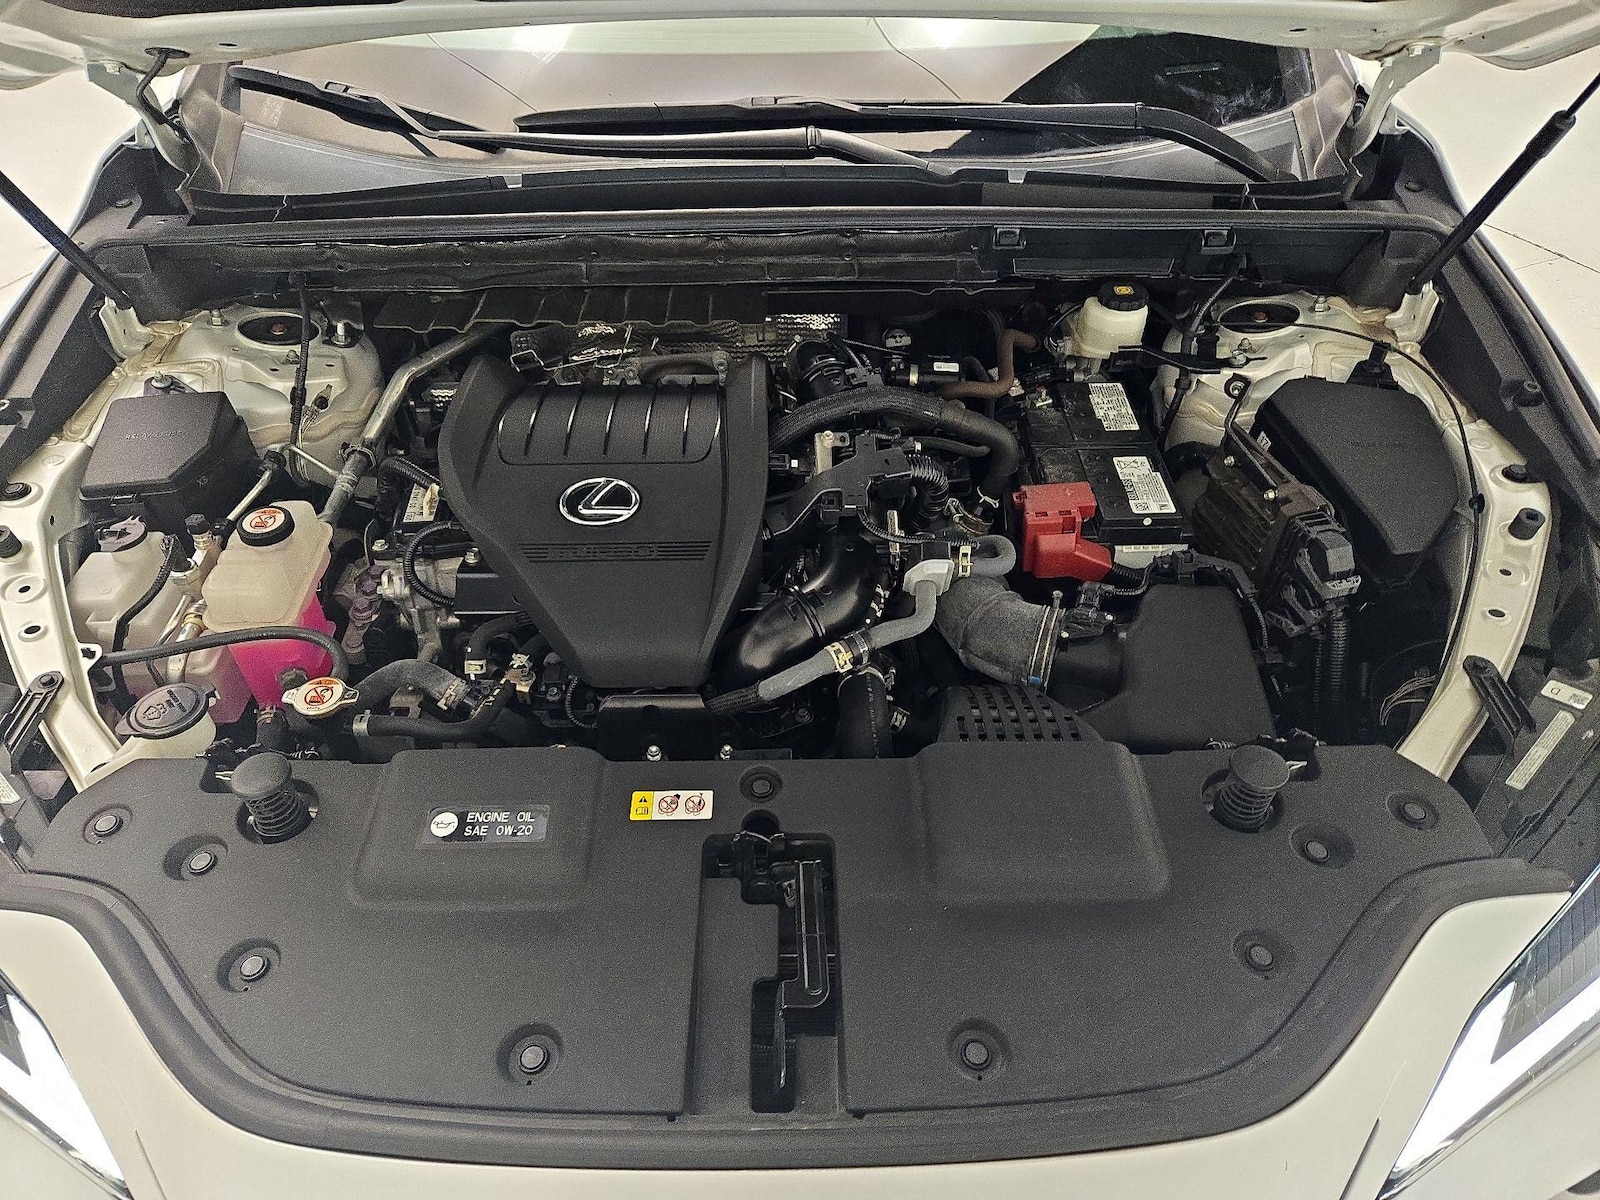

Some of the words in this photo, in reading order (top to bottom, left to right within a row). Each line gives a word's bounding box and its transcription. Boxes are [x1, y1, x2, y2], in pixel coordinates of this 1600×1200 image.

[466, 811, 510, 823] ENGINE
[516, 811, 536, 823] OIL
[463, 825, 489, 836] SAE
[495, 825, 533, 836] 0W-20
